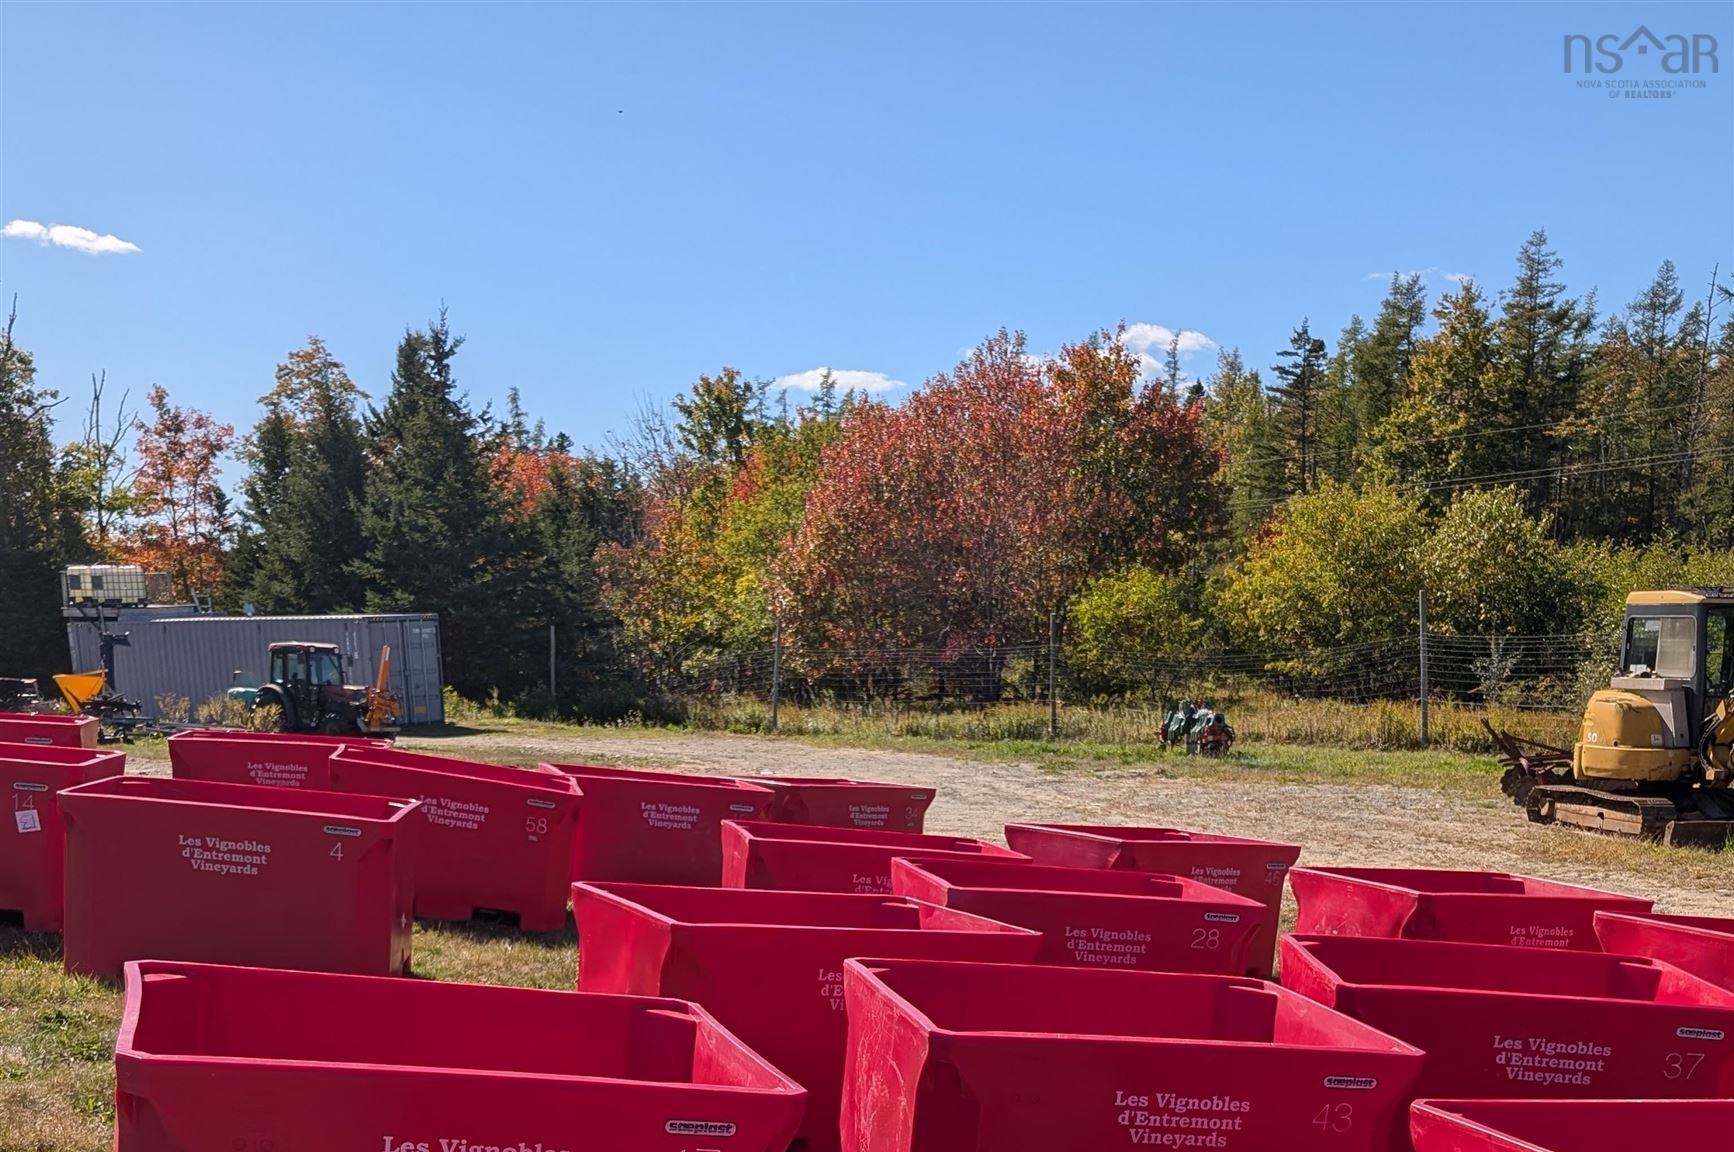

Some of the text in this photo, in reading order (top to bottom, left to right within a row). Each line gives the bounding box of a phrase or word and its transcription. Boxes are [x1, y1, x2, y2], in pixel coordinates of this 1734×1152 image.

[12, 793, 35, 810] 14
[440, 798, 490, 813] Vignobles
[641, 802, 701, 815] Les Vignobles
[421, 805, 486, 822] d'Entremont
[427, 814, 479, 830] Vineyards
[643, 811, 698, 823] d'Entremont
[525, 816, 548, 834] 58
[648, 818, 692, 830] Vineyards
[178, 834, 272, 853] Les Vignobles
[330, 842, 344, 861] 4
[182, 847, 268, 865] d'Entremont
[191, 859, 259, 875] Vineyards
[1191, 866, 1204, 876] Les
[853, 873, 872, 884] Les
[1065, 926, 1151, 942] Les Vignobles
[1191, 928, 1220, 949] 28
[1510, 925, 1574, 938] Les Vignobles
[1067, 938, 1147, 954] d'Entremont
[1511, 935, 1569, 947] d'Entremont
[1075, 951, 1137, 965] Vineyards
[818, 968, 842, 981] Les
[1493, 1035, 1612, 1057] Les Vignobles
[1495, 1051, 1605, 1072] d'Entremont
[1663, 1052, 1706, 1080] 37
[1506, 1066, 1591, 1086] Vineyards
[1114, 1090, 1250, 1113] Les Vignobles
[1117, 1110, 1243, 1131] d'Entremont
[1312, 1102, 1353, 1133] 43
[1129, 1128, 1227, 1149] Vineyards
